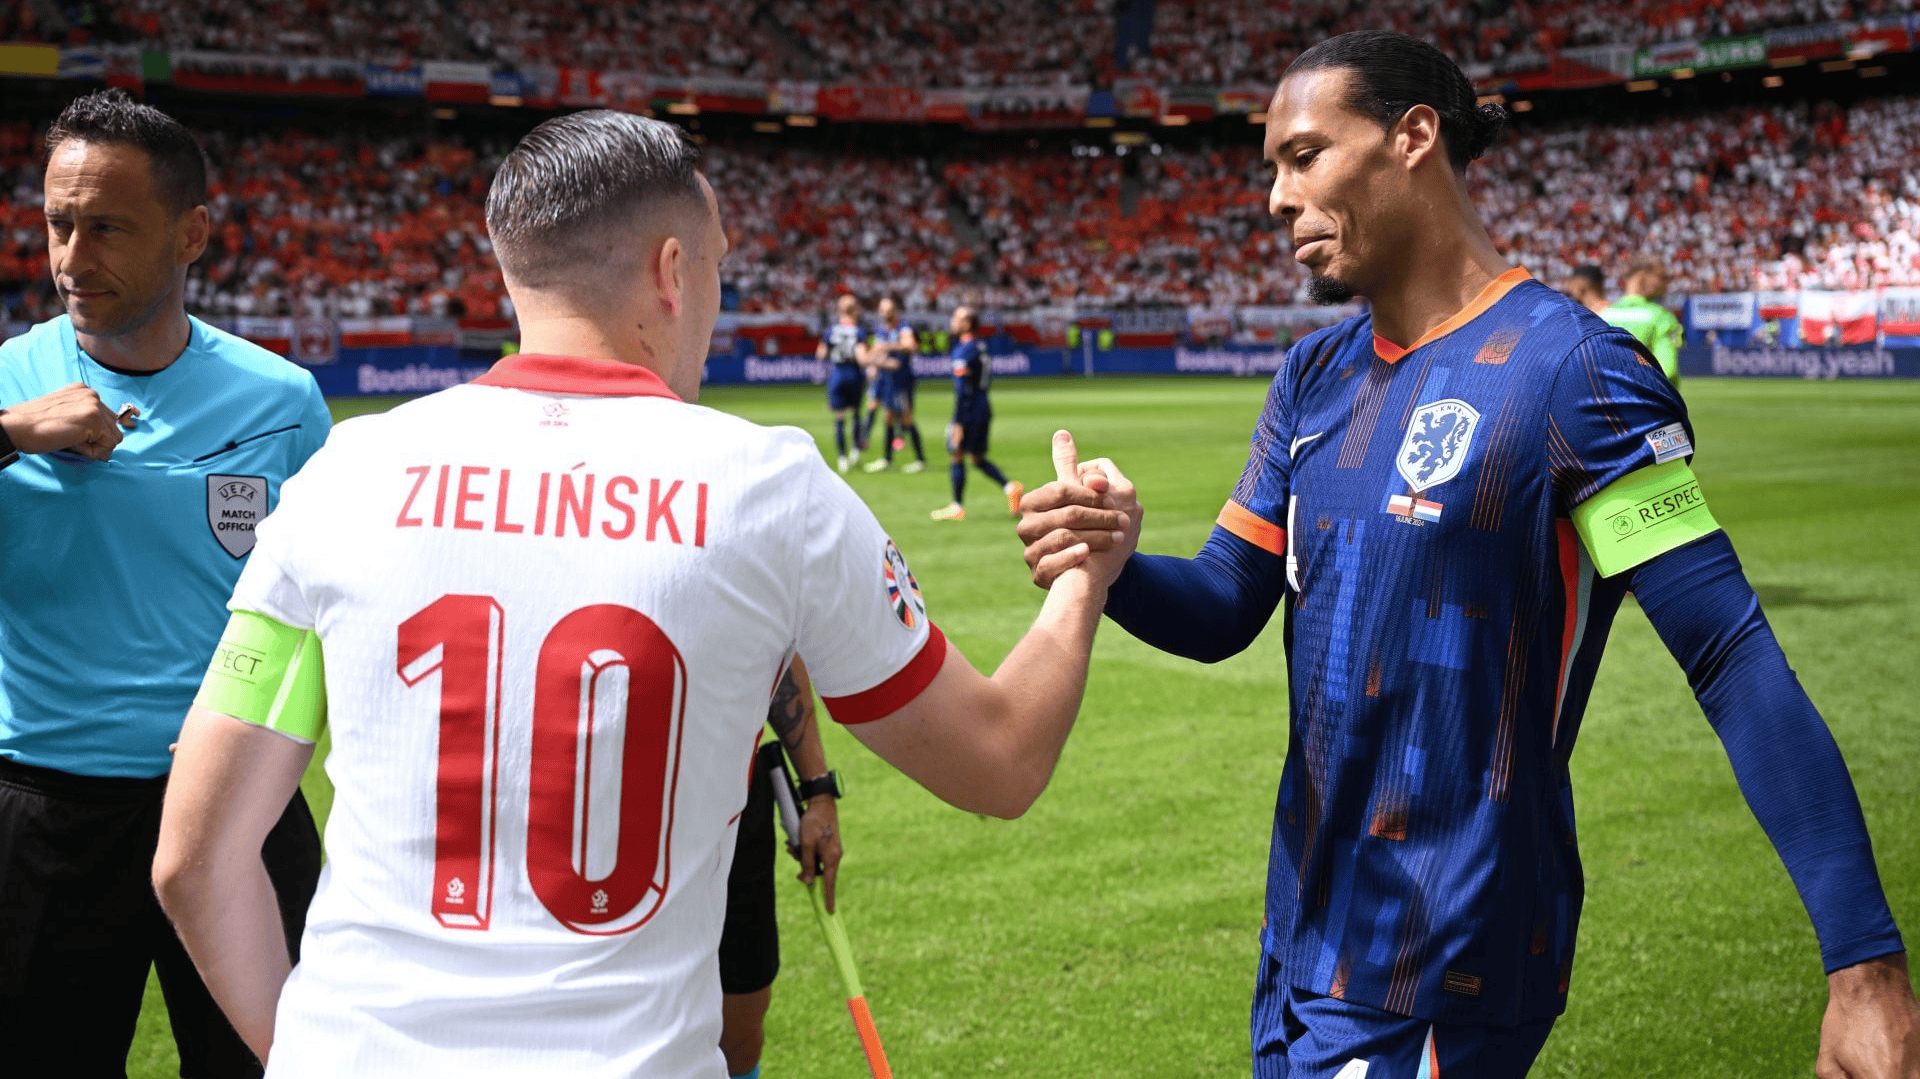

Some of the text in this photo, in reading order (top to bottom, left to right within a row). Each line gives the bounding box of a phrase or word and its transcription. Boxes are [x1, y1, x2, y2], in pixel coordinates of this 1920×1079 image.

[220, 484, 255, 500] UEFA
[396, 461, 708, 548] ZIELIŃSKI
[1638, 485, 1700, 524] RESPEC
[217, 521, 257, 532] OFFICIA
[221, 509, 256, 519] MATCH
[396, 593, 687, 937] 10
